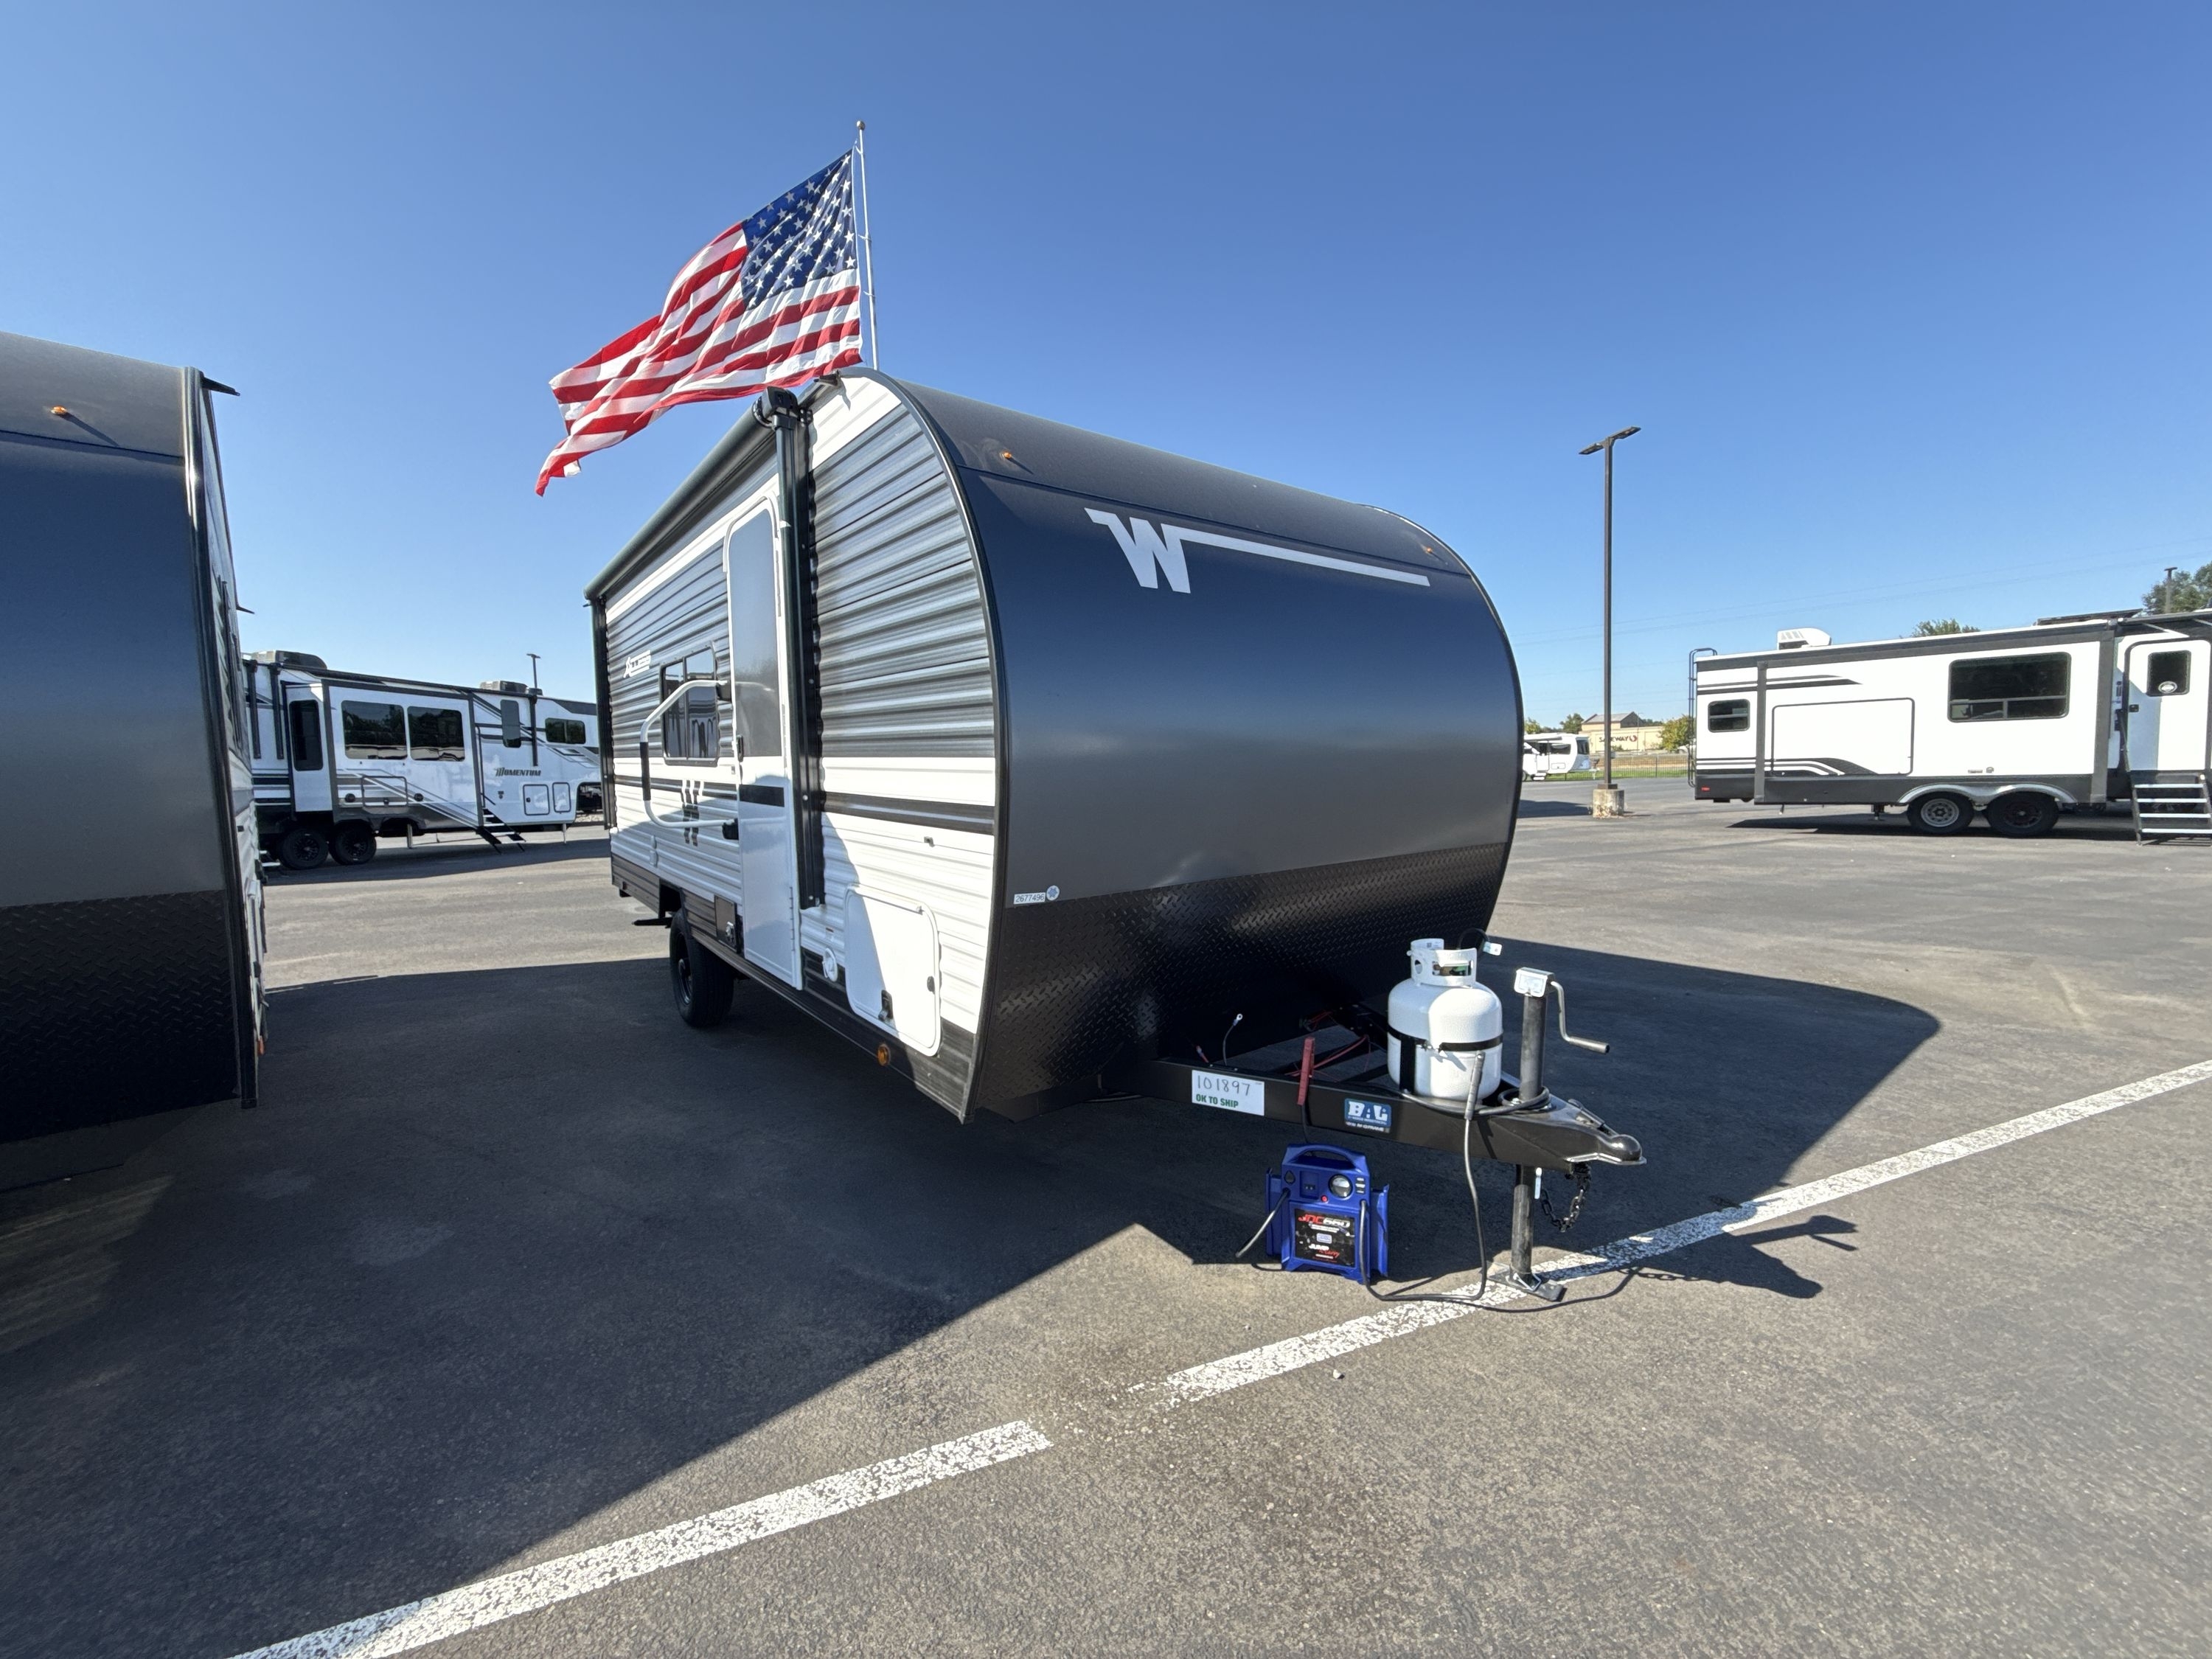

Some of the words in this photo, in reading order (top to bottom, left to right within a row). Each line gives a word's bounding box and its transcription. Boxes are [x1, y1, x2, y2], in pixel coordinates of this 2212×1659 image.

[1197, 1075, 1251, 1096] 101897
[1196, 1093, 1207, 1103] OK
[1208, 1096, 1218, 1105] TO
[1220, 1098, 1239, 1108] SHIP
[1348, 1101, 1388, 1121] BAL
